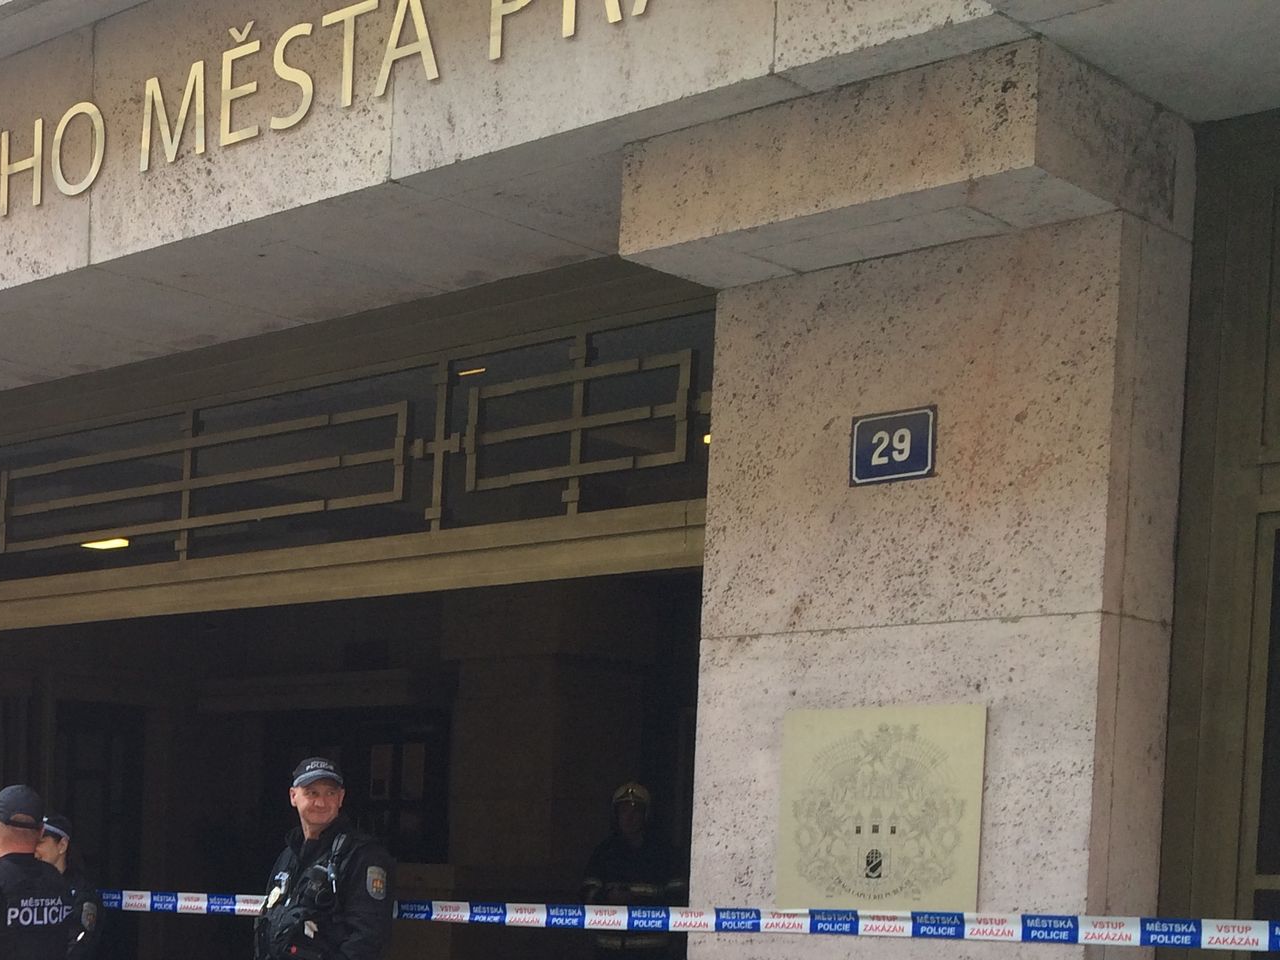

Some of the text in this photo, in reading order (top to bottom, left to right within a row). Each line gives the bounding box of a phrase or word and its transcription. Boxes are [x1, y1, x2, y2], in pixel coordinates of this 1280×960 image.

[139, 0, 439, 173] MĚSTA
[871, 428, 911, 465] 29
[20, 896, 63, 907] MĚSTSKÁ
[7, 905, 73, 926] POLICIE
[679, 911, 705, 919] VSTUP
[719, 909, 757, 919] MĚSTSKÁ
[870, 914, 898, 922] VSTUP
[551, 917, 579, 926] POLICIE
[633, 919, 662, 928] POLICIE
[721, 920, 753, 930] POLICIE
[976, 917, 1007, 926] VSTUP
[1026, 917, 1073, 929] MĚSTSKÁ
[1092, 920, 1125, 930] VSTUP
[1146, 921, 1196, 932] MĚSTSKÁ
[817, 922, 850, 932] POLICIE
[919, 926, 956, 936] POLICIE
[1216, 924, 1252, 934] VSTUP
[1030, 930, 1069, 940] POLICIE
[1150, 934, 1192, 945] POLICIE
